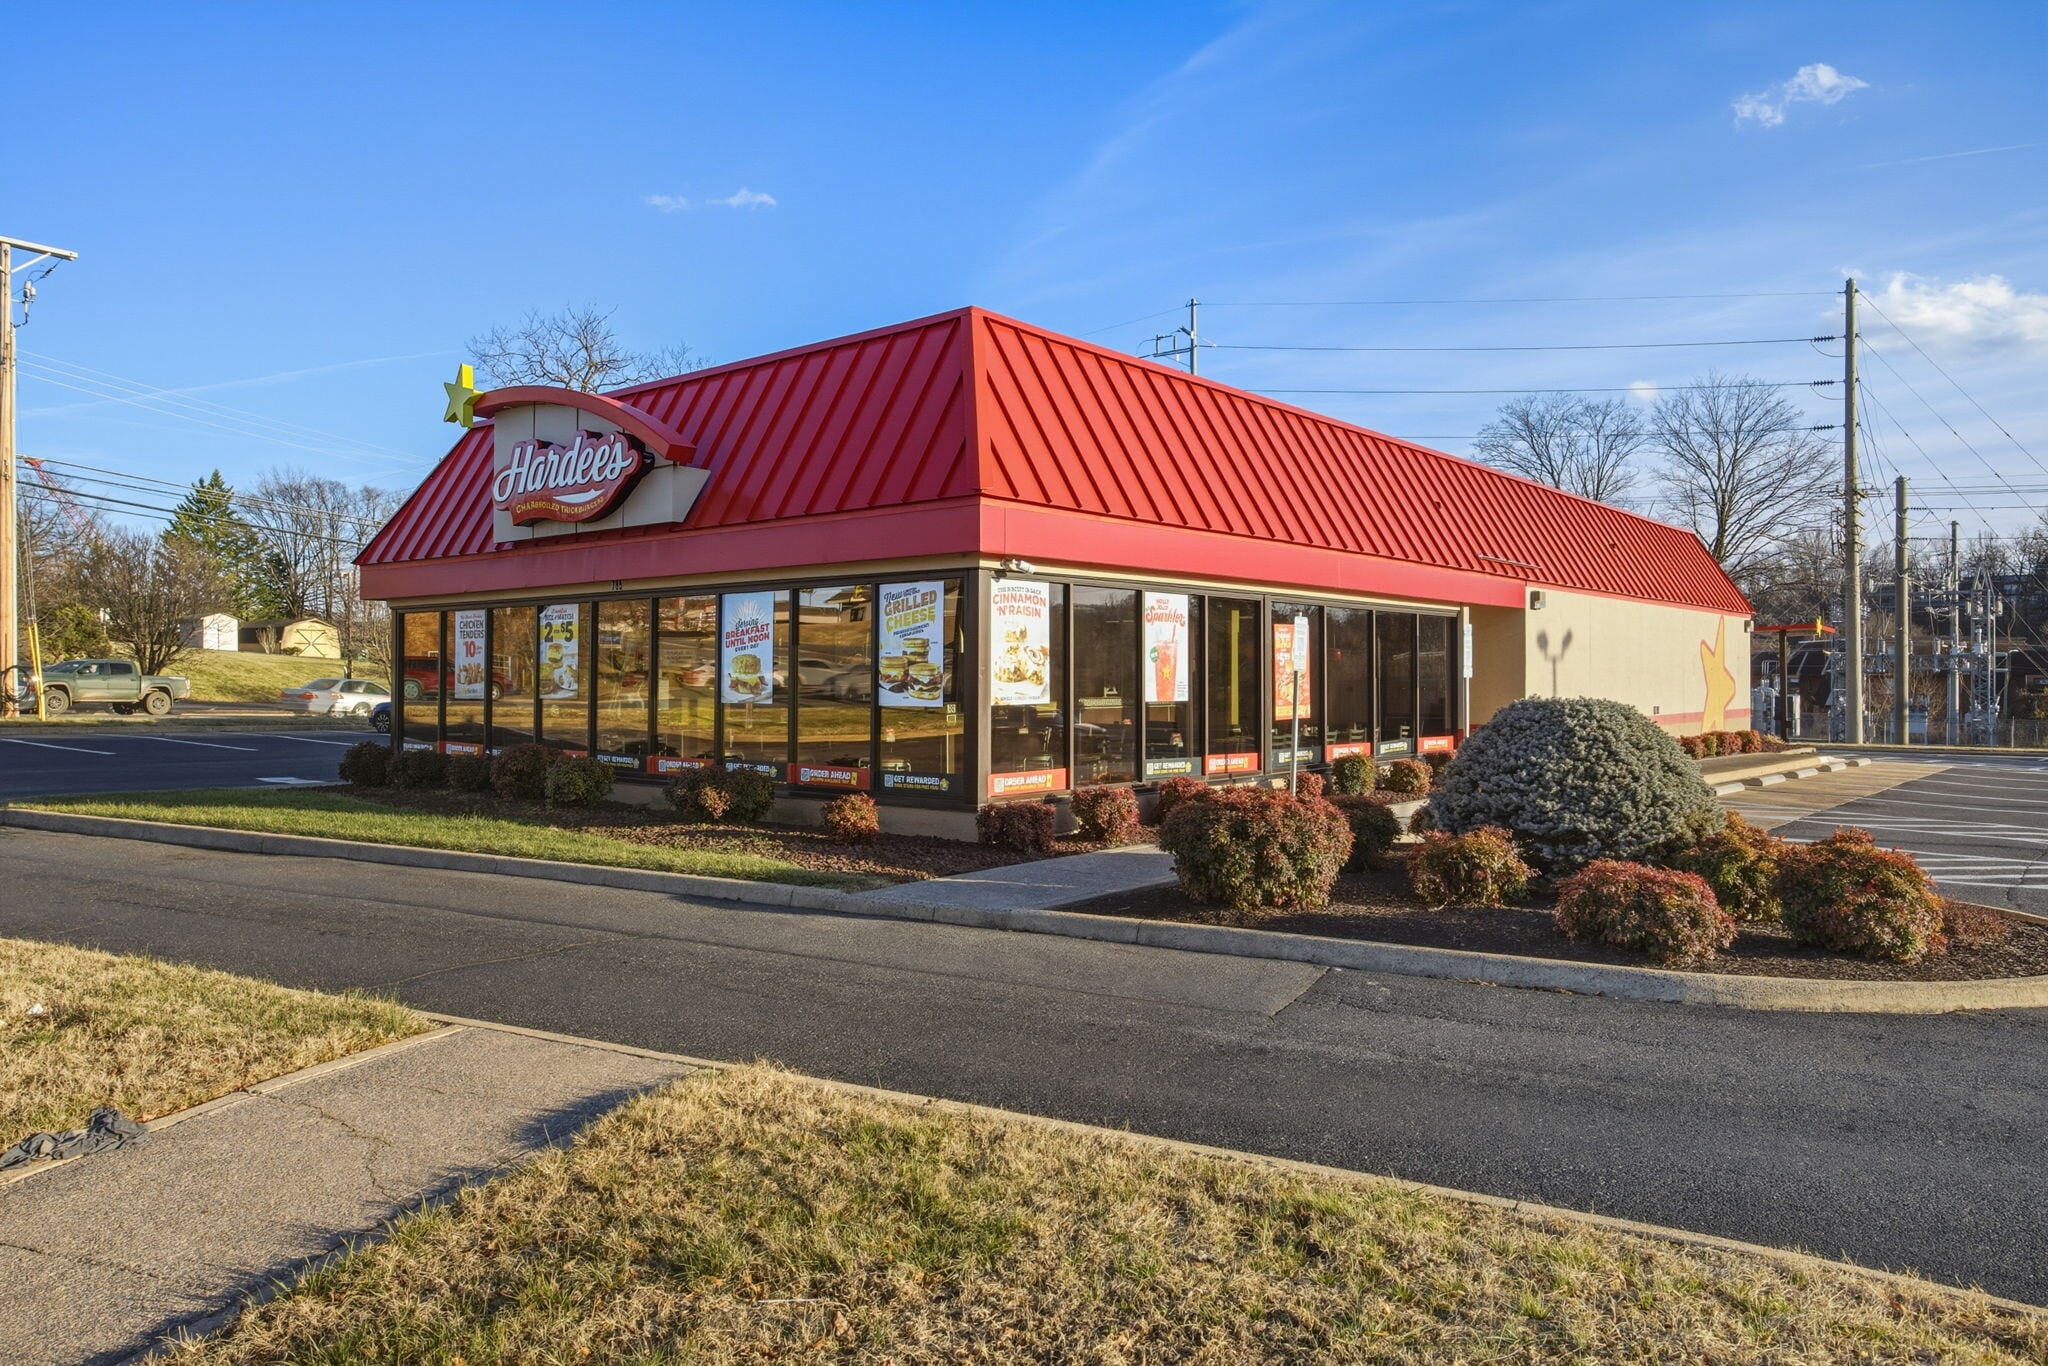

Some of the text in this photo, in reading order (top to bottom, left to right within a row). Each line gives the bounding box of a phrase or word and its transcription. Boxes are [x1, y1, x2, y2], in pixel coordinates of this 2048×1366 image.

[493, 434, 633, 502] Hardee's
[884, 590, 938, 617] GRILLED
[992, 593, 1047, 608] CINNAMON
[1009, 604, 1041, 618] RAISIN
[459, 620, 484, 630] CHICKEN
[886, 605, 936, 634] CHEESE
[459, 630, 484, 639] TENDERS
[544, 621, 554, 643] 2
[560, 620, 574, 643] $5
[726, 623, 770, 640] BREAKFAST
[726, 632, 770, 649] UNTIL NOON
[810, 769, 851, 780] ORDER AHEAD
[894, 774, 940, 785] GET REWARDED
[1004, 775, 1046, 786] ORDER AHEAD
